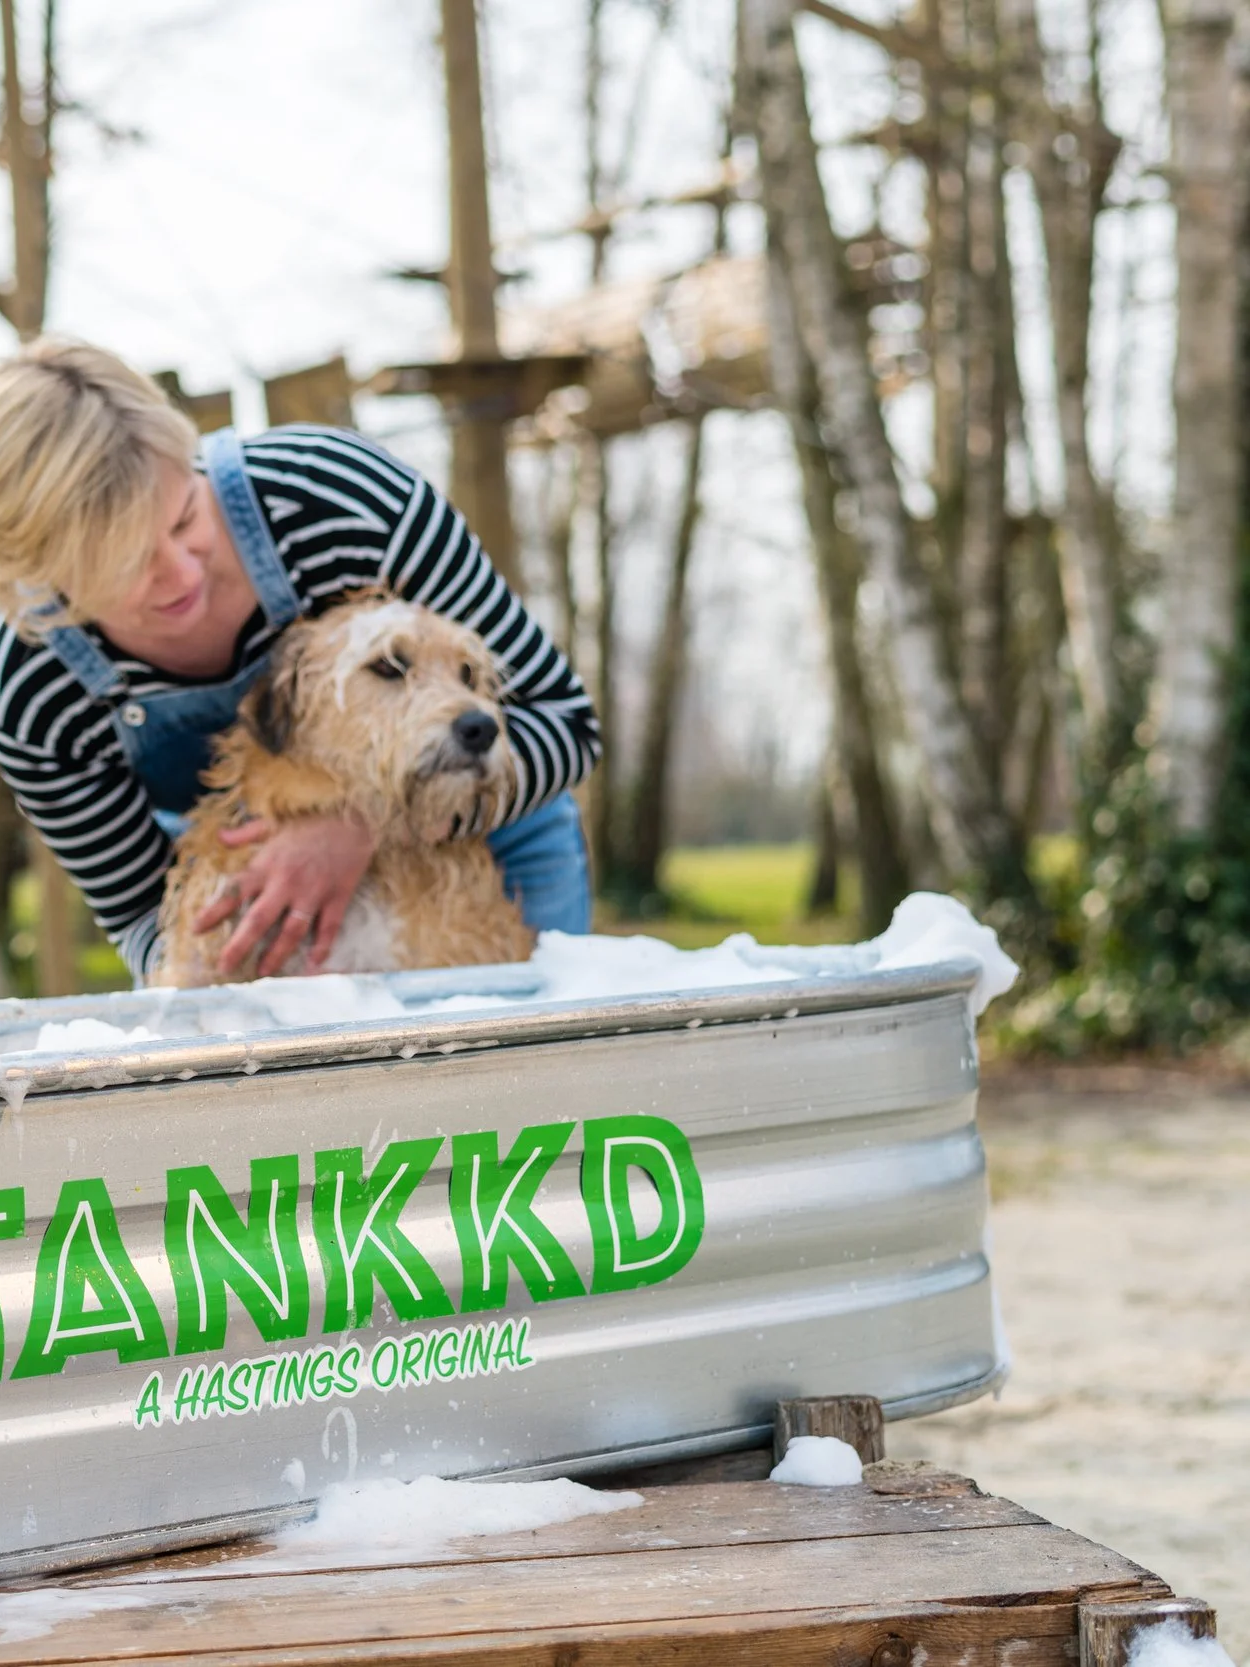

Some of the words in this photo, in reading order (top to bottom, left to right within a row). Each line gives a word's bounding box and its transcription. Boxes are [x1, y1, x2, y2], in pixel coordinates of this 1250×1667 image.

[136, 1376, 161, 1426] A
[174, 1346, 362, 1421] HASTINGS
[370, 1321, 534, 1389] ORIGINAL
